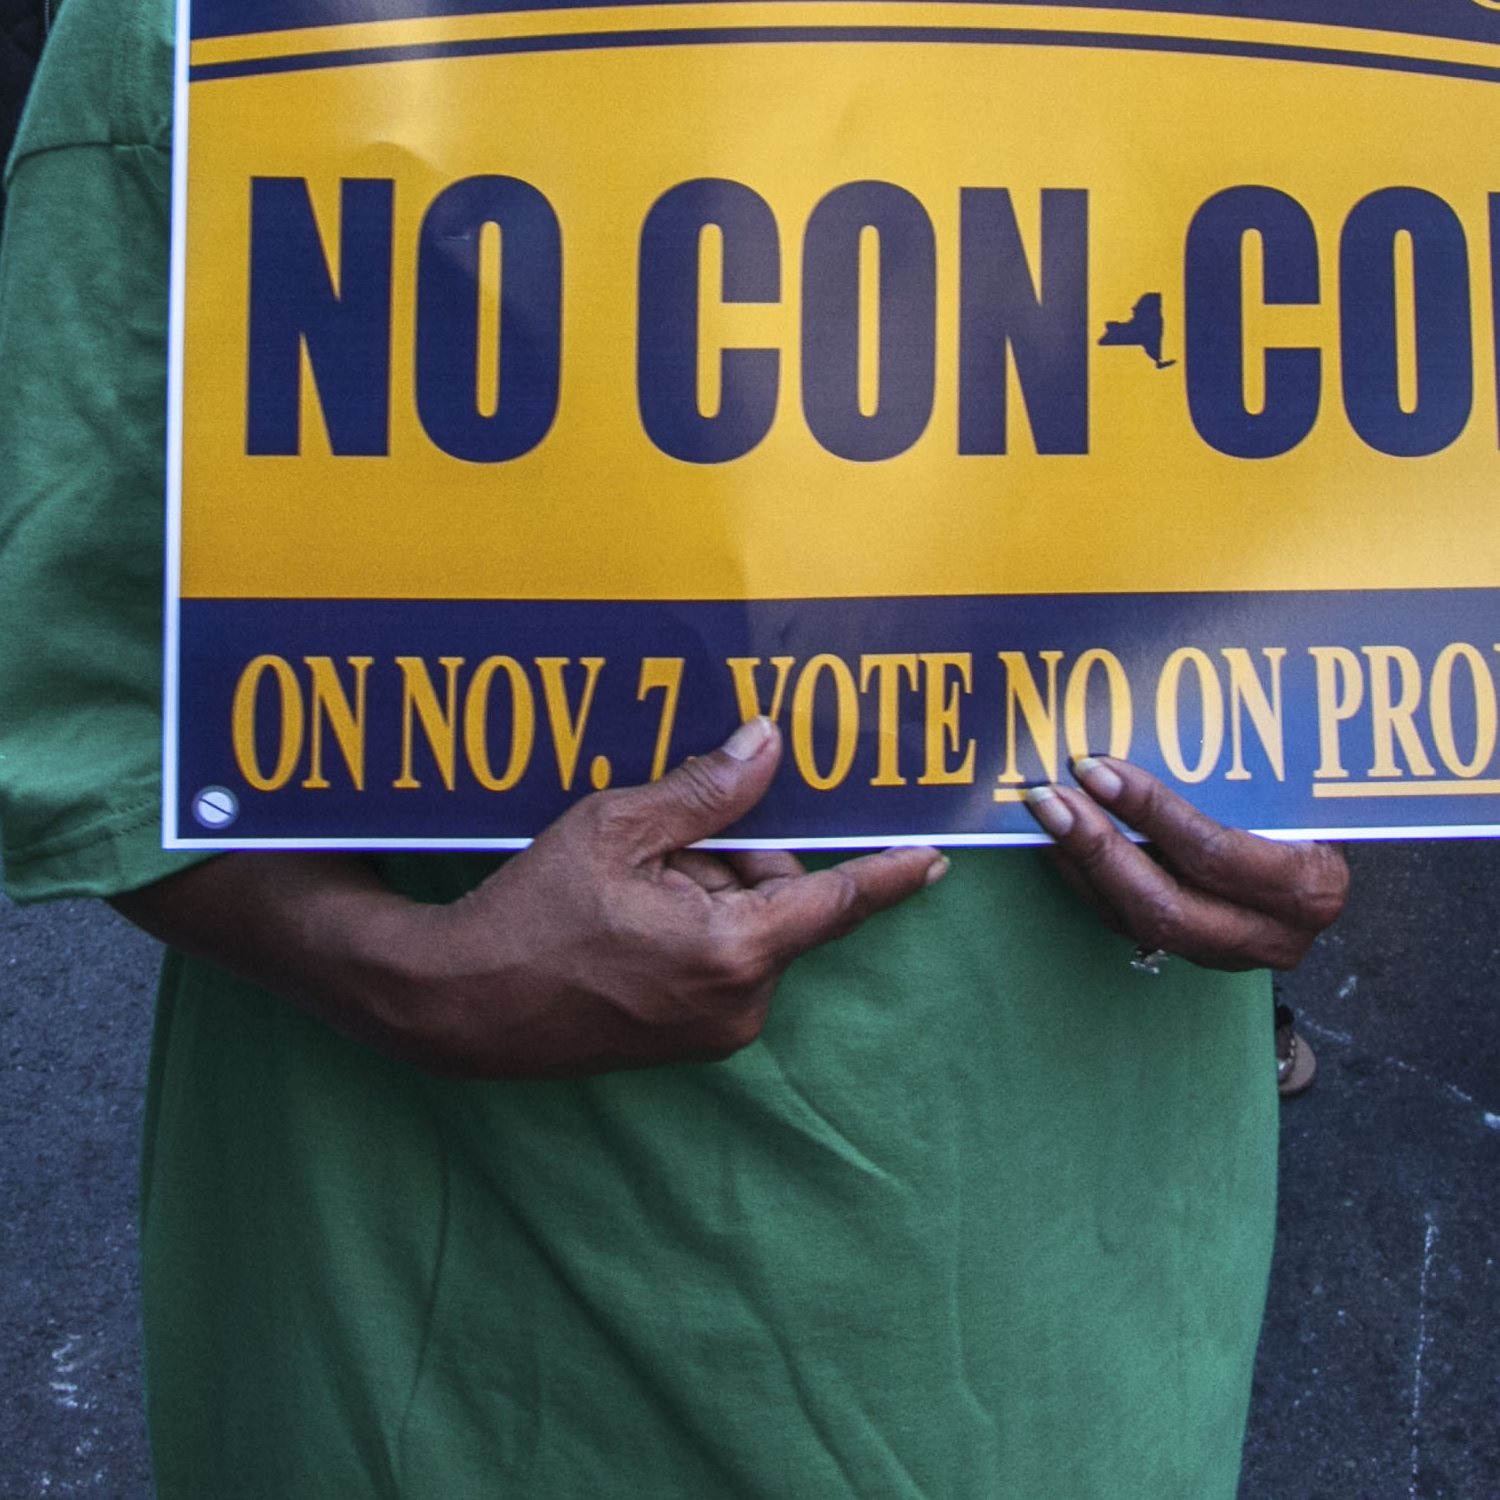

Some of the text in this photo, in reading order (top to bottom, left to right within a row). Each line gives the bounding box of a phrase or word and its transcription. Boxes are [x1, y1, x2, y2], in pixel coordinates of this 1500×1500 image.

[244, 172, 565, 465] NO
[231, 654, 374, 791] ON
[392, 654, 612, 792] NOV.
[726, 651, 977, 791] VOTE
[997, 647, 1135, 786] NO
[1155, 645, 1287, 784] ON
